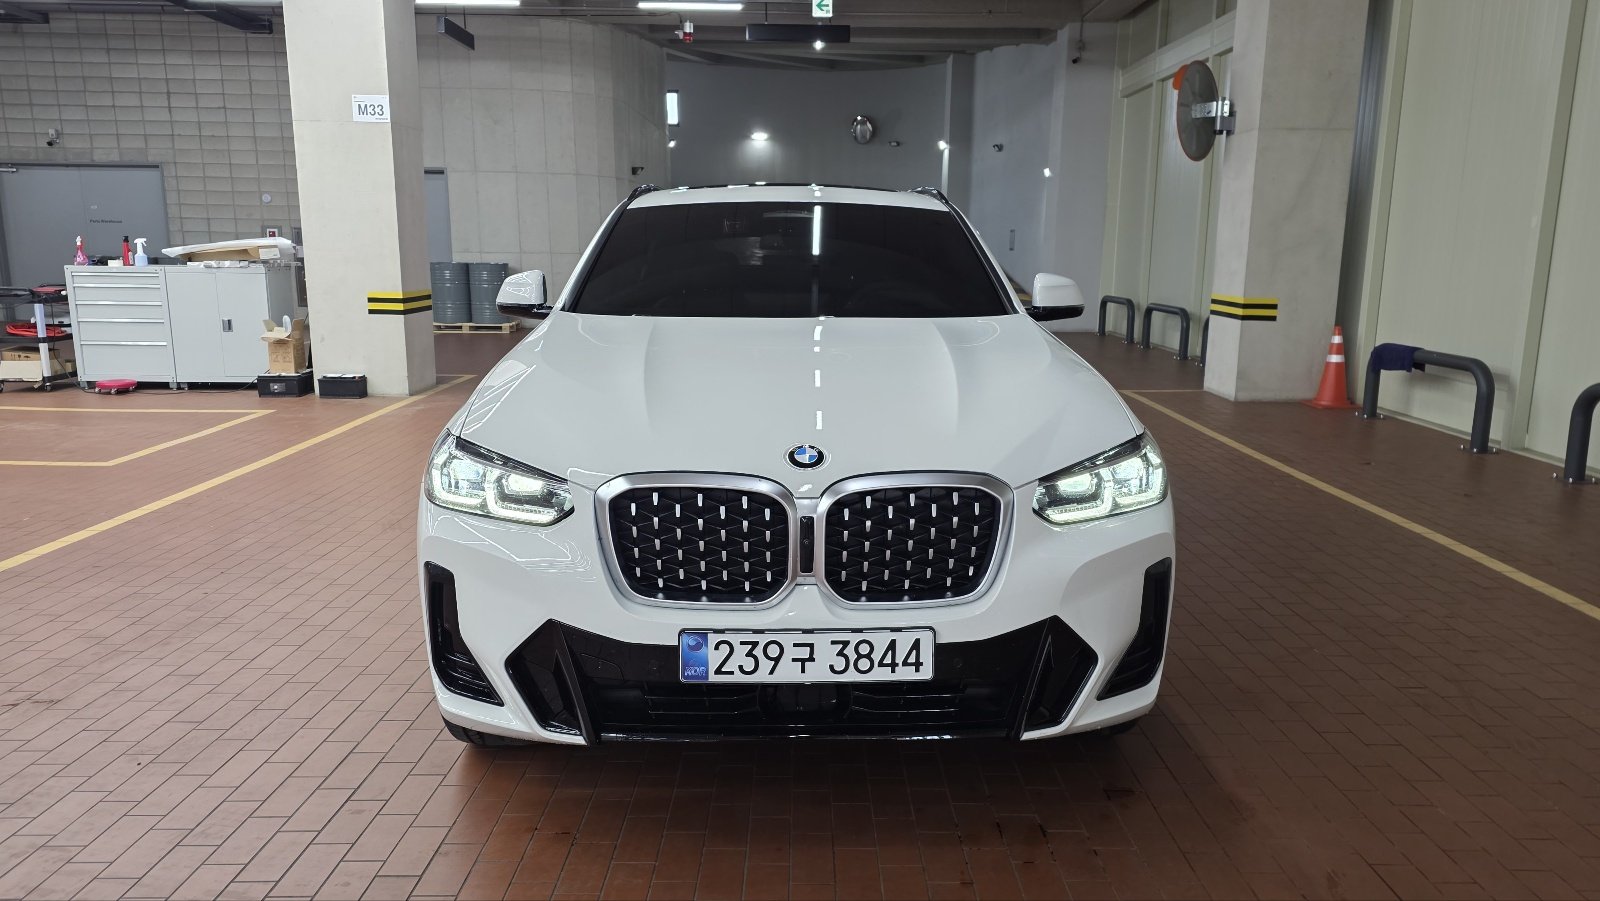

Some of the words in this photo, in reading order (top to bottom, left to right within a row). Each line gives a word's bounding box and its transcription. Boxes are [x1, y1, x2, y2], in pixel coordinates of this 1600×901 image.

[357, 103, 385, 116] M33
[713, 639, 816, 675] 239구
[828, 637, 924, 675] 3844
